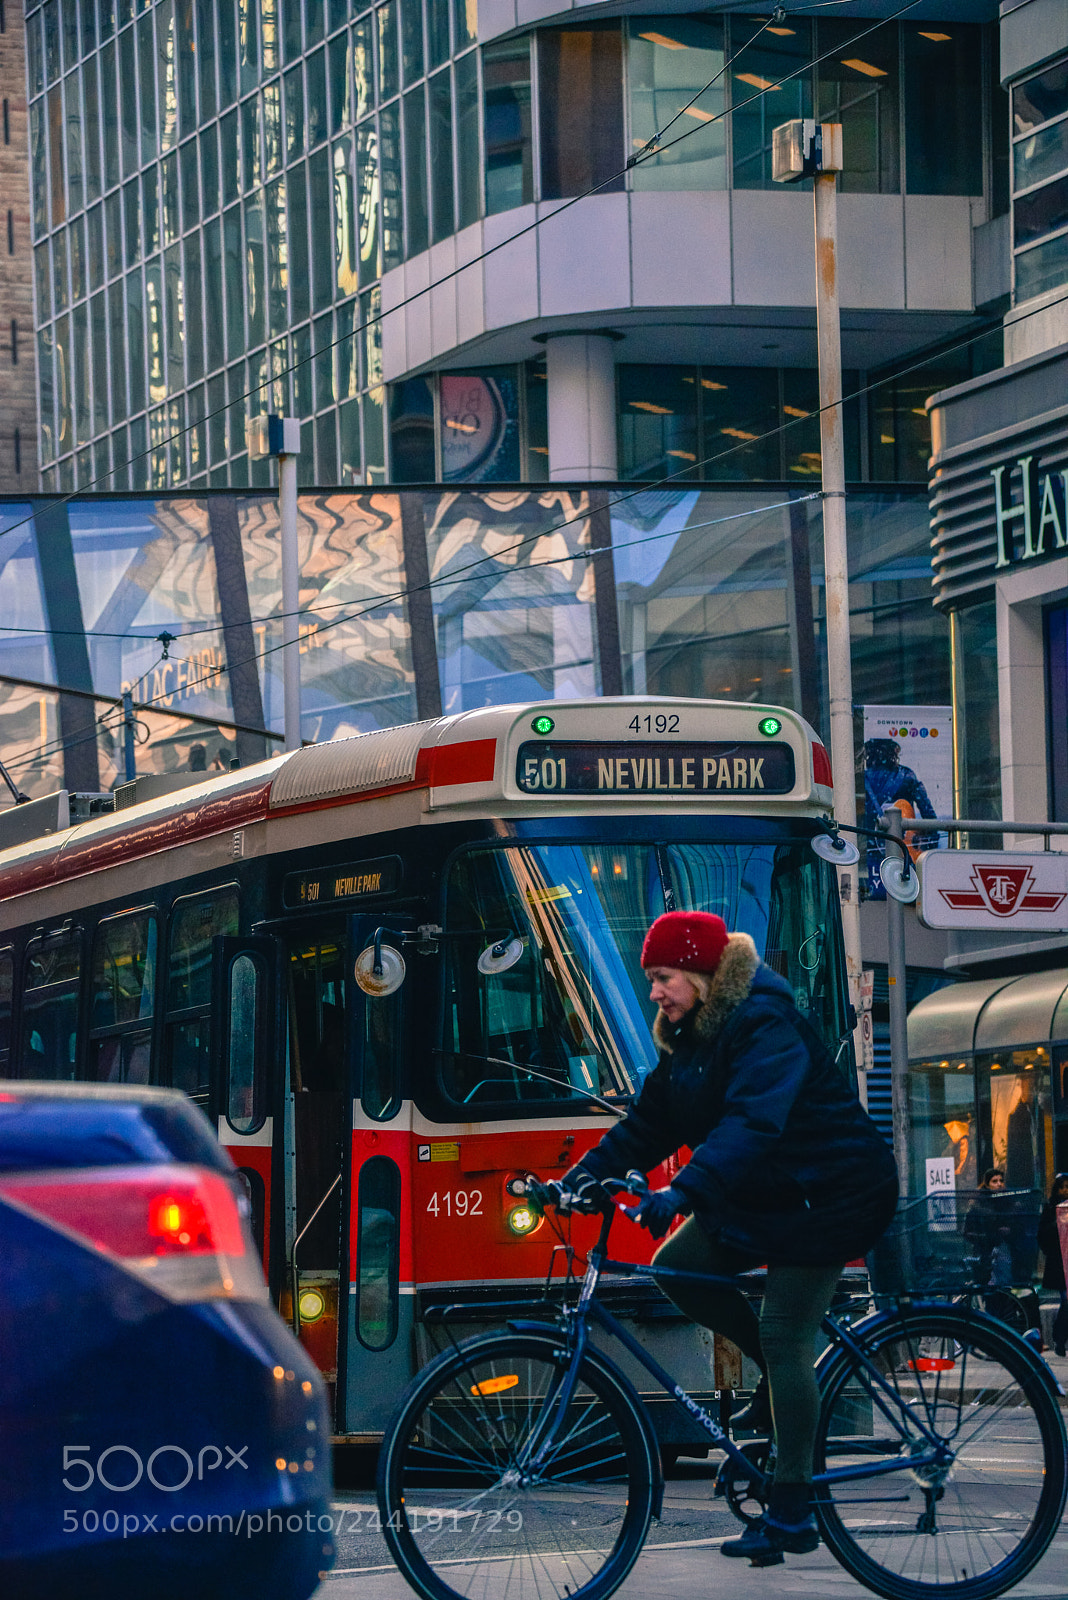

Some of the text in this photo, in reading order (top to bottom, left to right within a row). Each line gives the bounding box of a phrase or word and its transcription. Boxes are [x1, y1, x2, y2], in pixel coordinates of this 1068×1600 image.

[628, 714, 680, 733] 4192
[524, 758, 765, 789] 501 NEVILLE PARK
[307, 882, 320, 901] 501
[334, 876, 363, 897] NEVILLE
[362, 873, 382, 893] PARK
[930, 1169, 951, 1186] SALE
[426, 1189, 483, 1217] 4192
